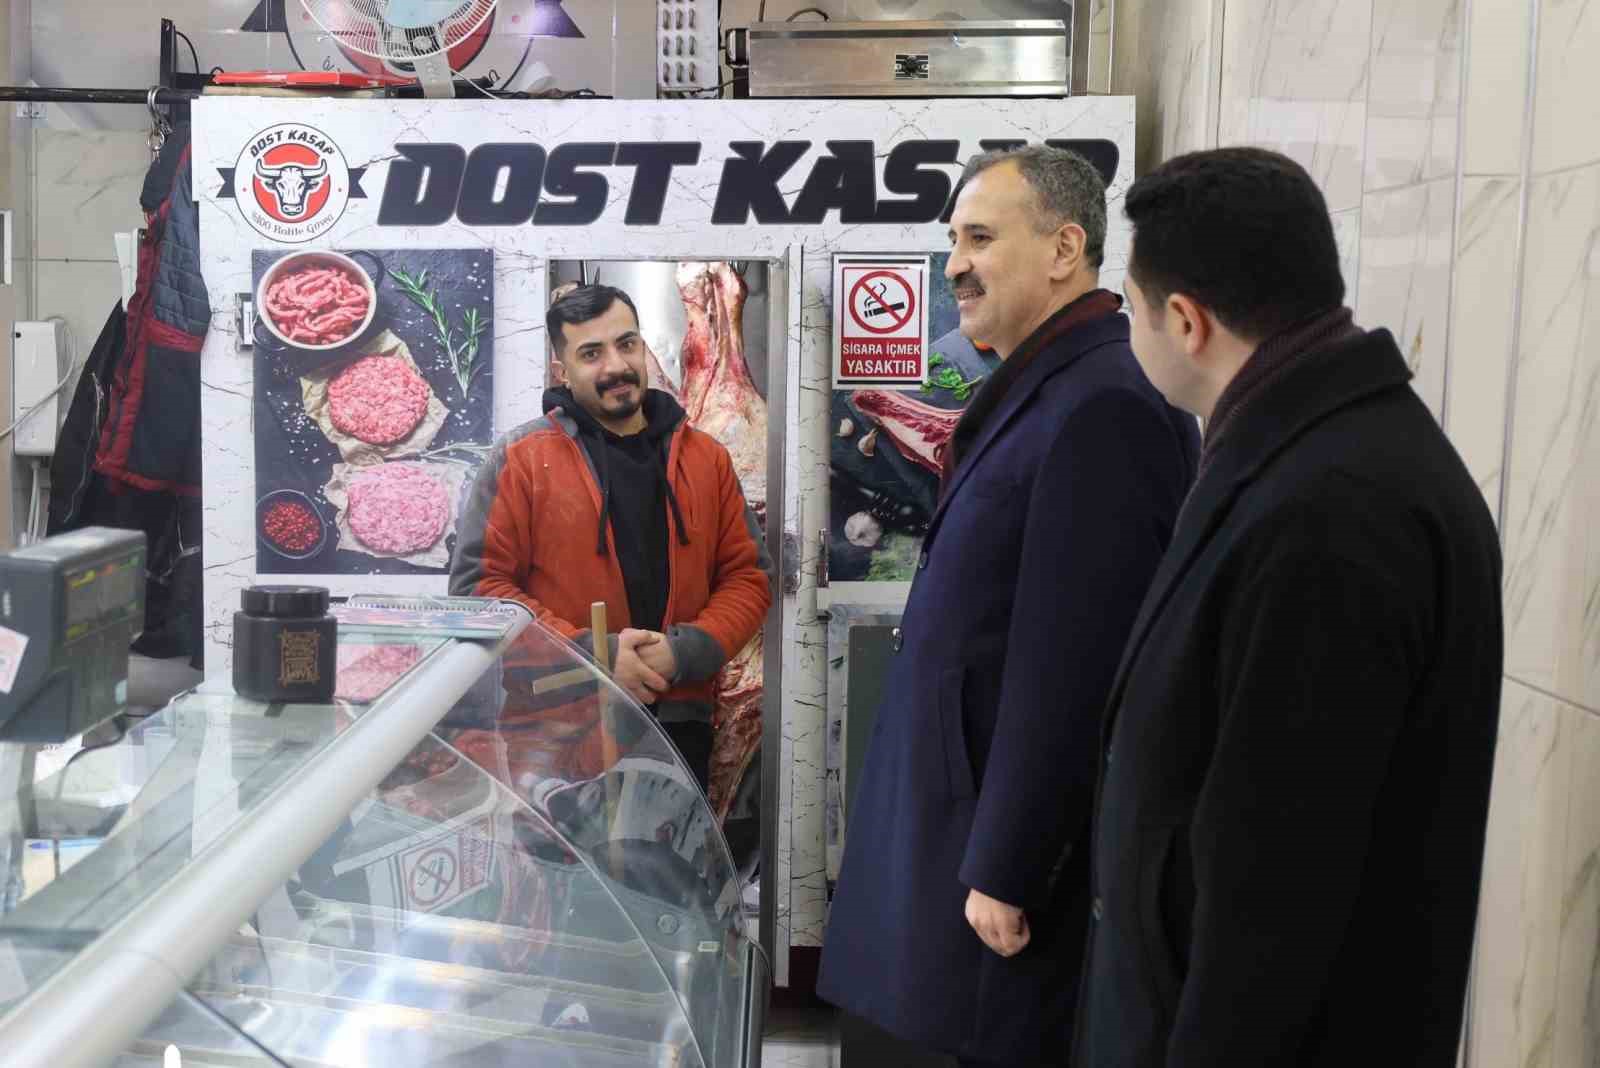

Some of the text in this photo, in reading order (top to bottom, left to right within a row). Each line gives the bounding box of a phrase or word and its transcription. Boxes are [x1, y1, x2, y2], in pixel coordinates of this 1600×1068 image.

[250, 129, 335, 158] DOST KASAP
[377, 139, 1120, 226] DOST KAS
[842, 341, 920, 358] SİGARA İÇMEK
[847, 359, 917, 374] YASAKTIR
